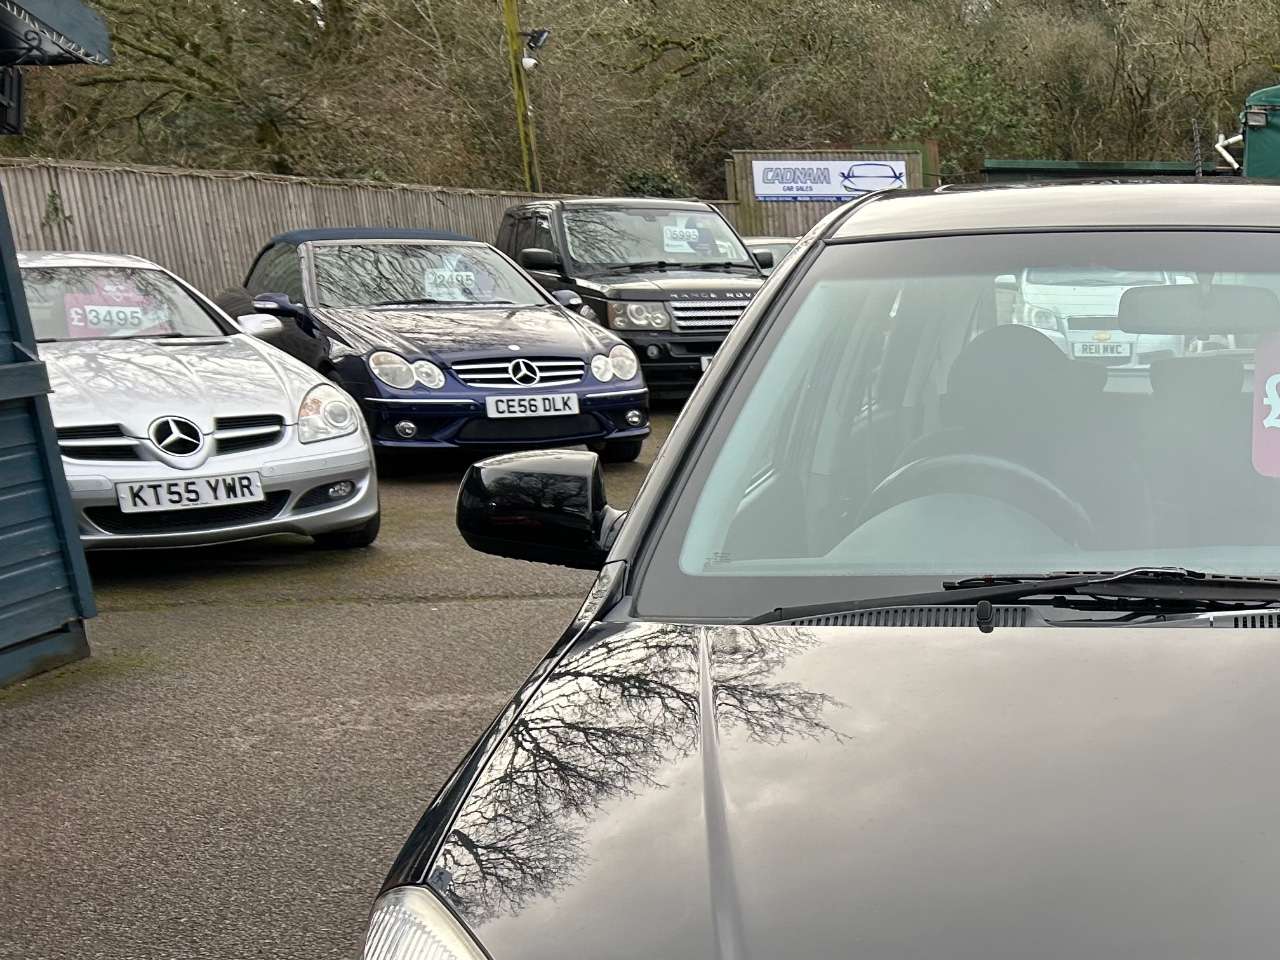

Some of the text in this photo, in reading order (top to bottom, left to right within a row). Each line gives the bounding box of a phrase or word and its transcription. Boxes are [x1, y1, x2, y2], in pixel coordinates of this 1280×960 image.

[762, 167, 831, 184] CADNAM
[495, 396, 572, 414] CE56 DLK
[128, 476, 255, 507] KT55 YWR
